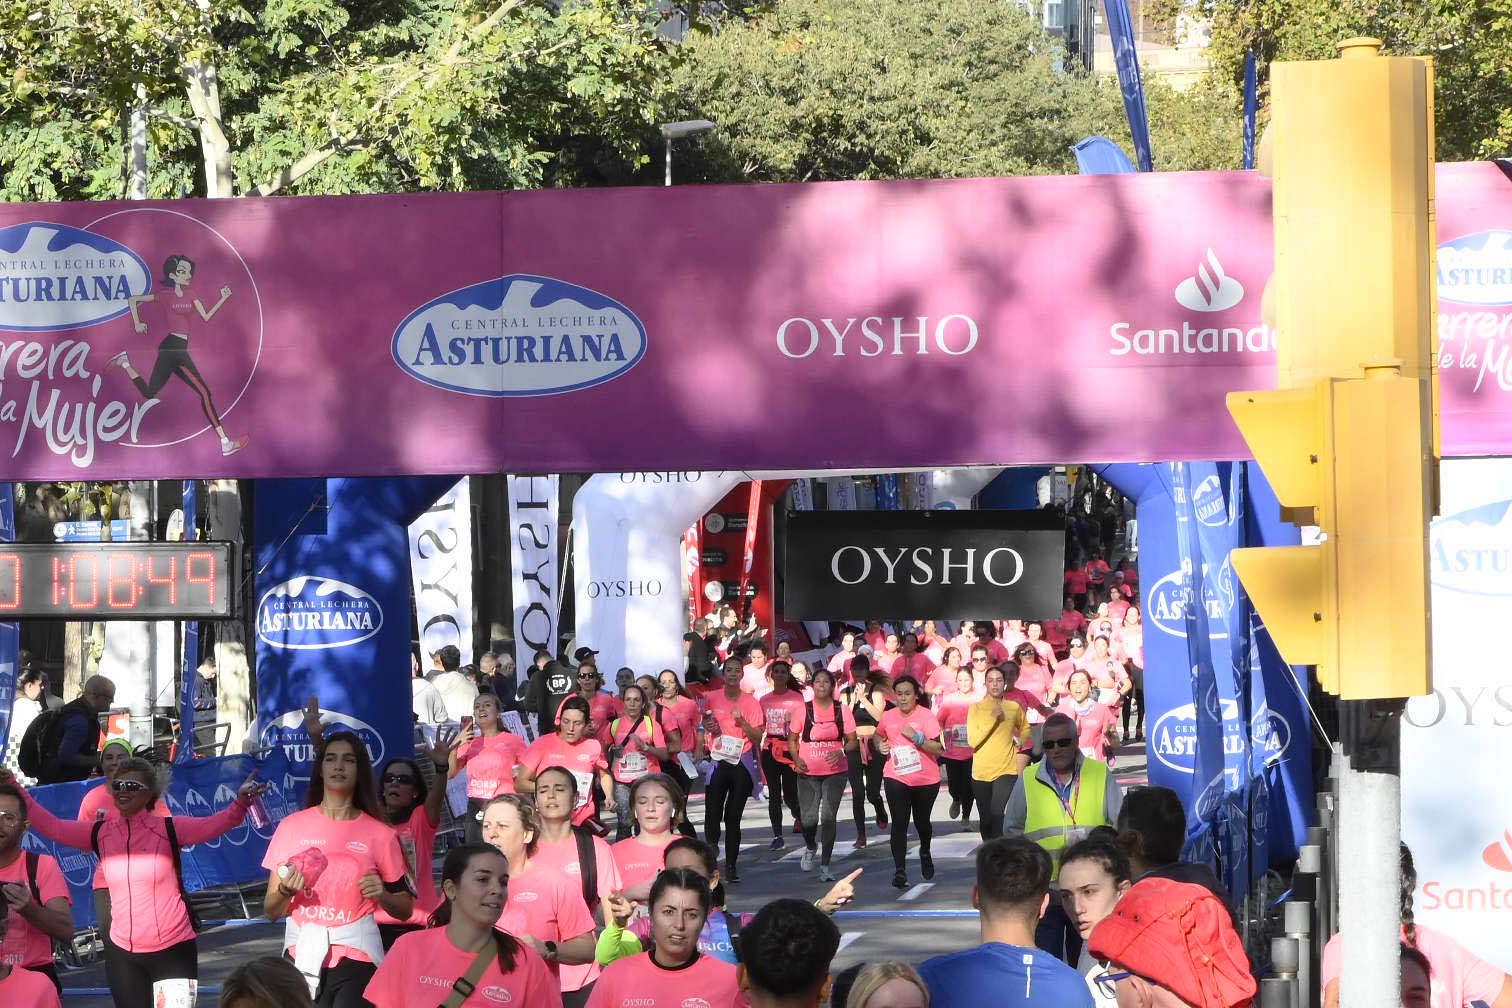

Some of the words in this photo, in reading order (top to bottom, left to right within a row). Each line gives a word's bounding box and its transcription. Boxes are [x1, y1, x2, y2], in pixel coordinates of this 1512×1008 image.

[54, 257, 126, 270] LECHERA
[451, 318, 526, 331] CENTRAL
[532, 314, 619, 329] LECHERA
[412, 322, 628, 367] ASTURIANA
[776, 314, 980, 359] OYSHO
[1459, 345, 1477, 370] la
[11, 374, 161, 468] Mujer
[831, 545, 1024, 586] OYSHO
[587, 580, 661, 598] OYSHO
[273, 600, 317, 610] CENTRAL
[320, 600, 370, 610] LECHERA
[261, 607, 374, 633] ASTURIANA
[552, 678, 566, 689] BP
